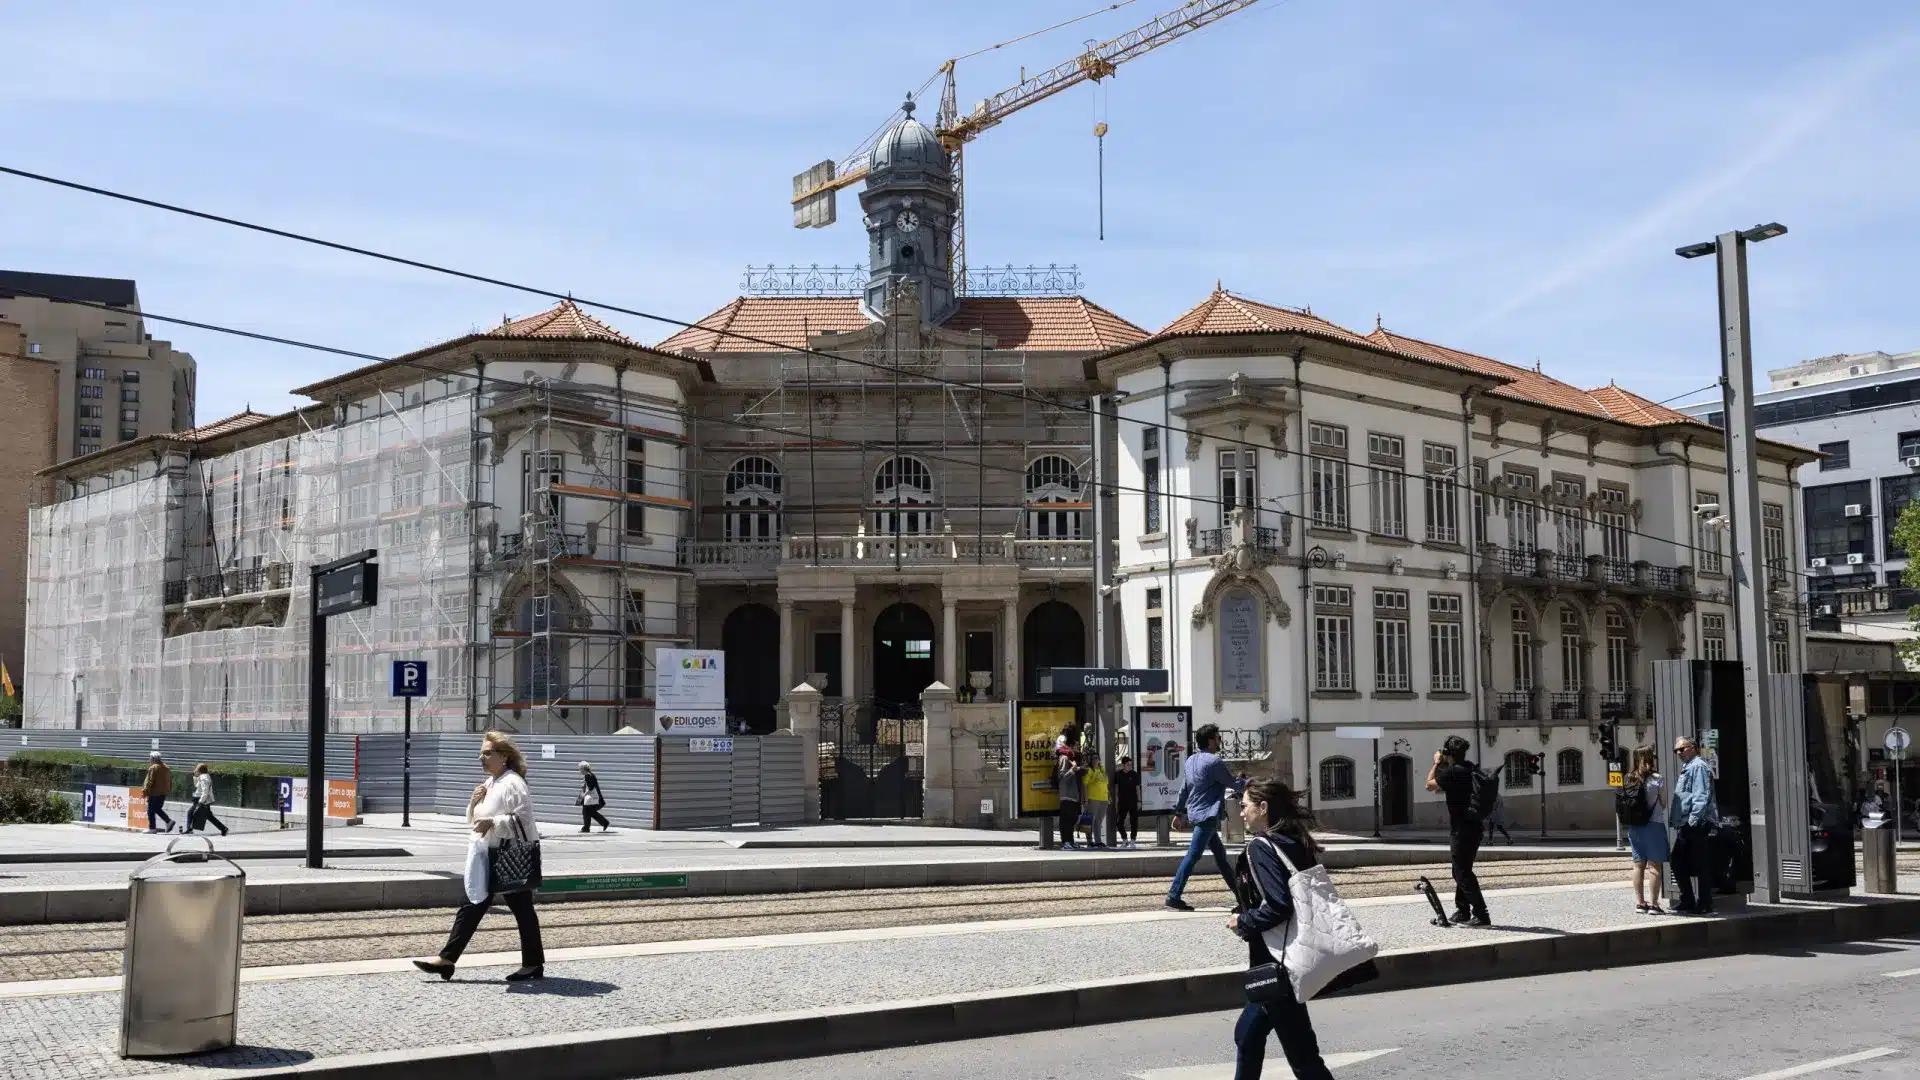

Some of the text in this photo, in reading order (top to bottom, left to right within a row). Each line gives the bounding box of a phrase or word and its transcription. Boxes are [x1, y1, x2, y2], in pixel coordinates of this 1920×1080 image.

[682, 658, 717, 669] GAIA
[404, 667, 418, 686] P
[1083, 674, 1140, 686] Câmara Gaia
[674, 716, 716, 728] EDILages
[1611, 775, 1621, 784] 30
[1159, 787, 1169, 796] VS
[84, 790, 94, 816] P
[106, 795, 122, 811] 2,5€
